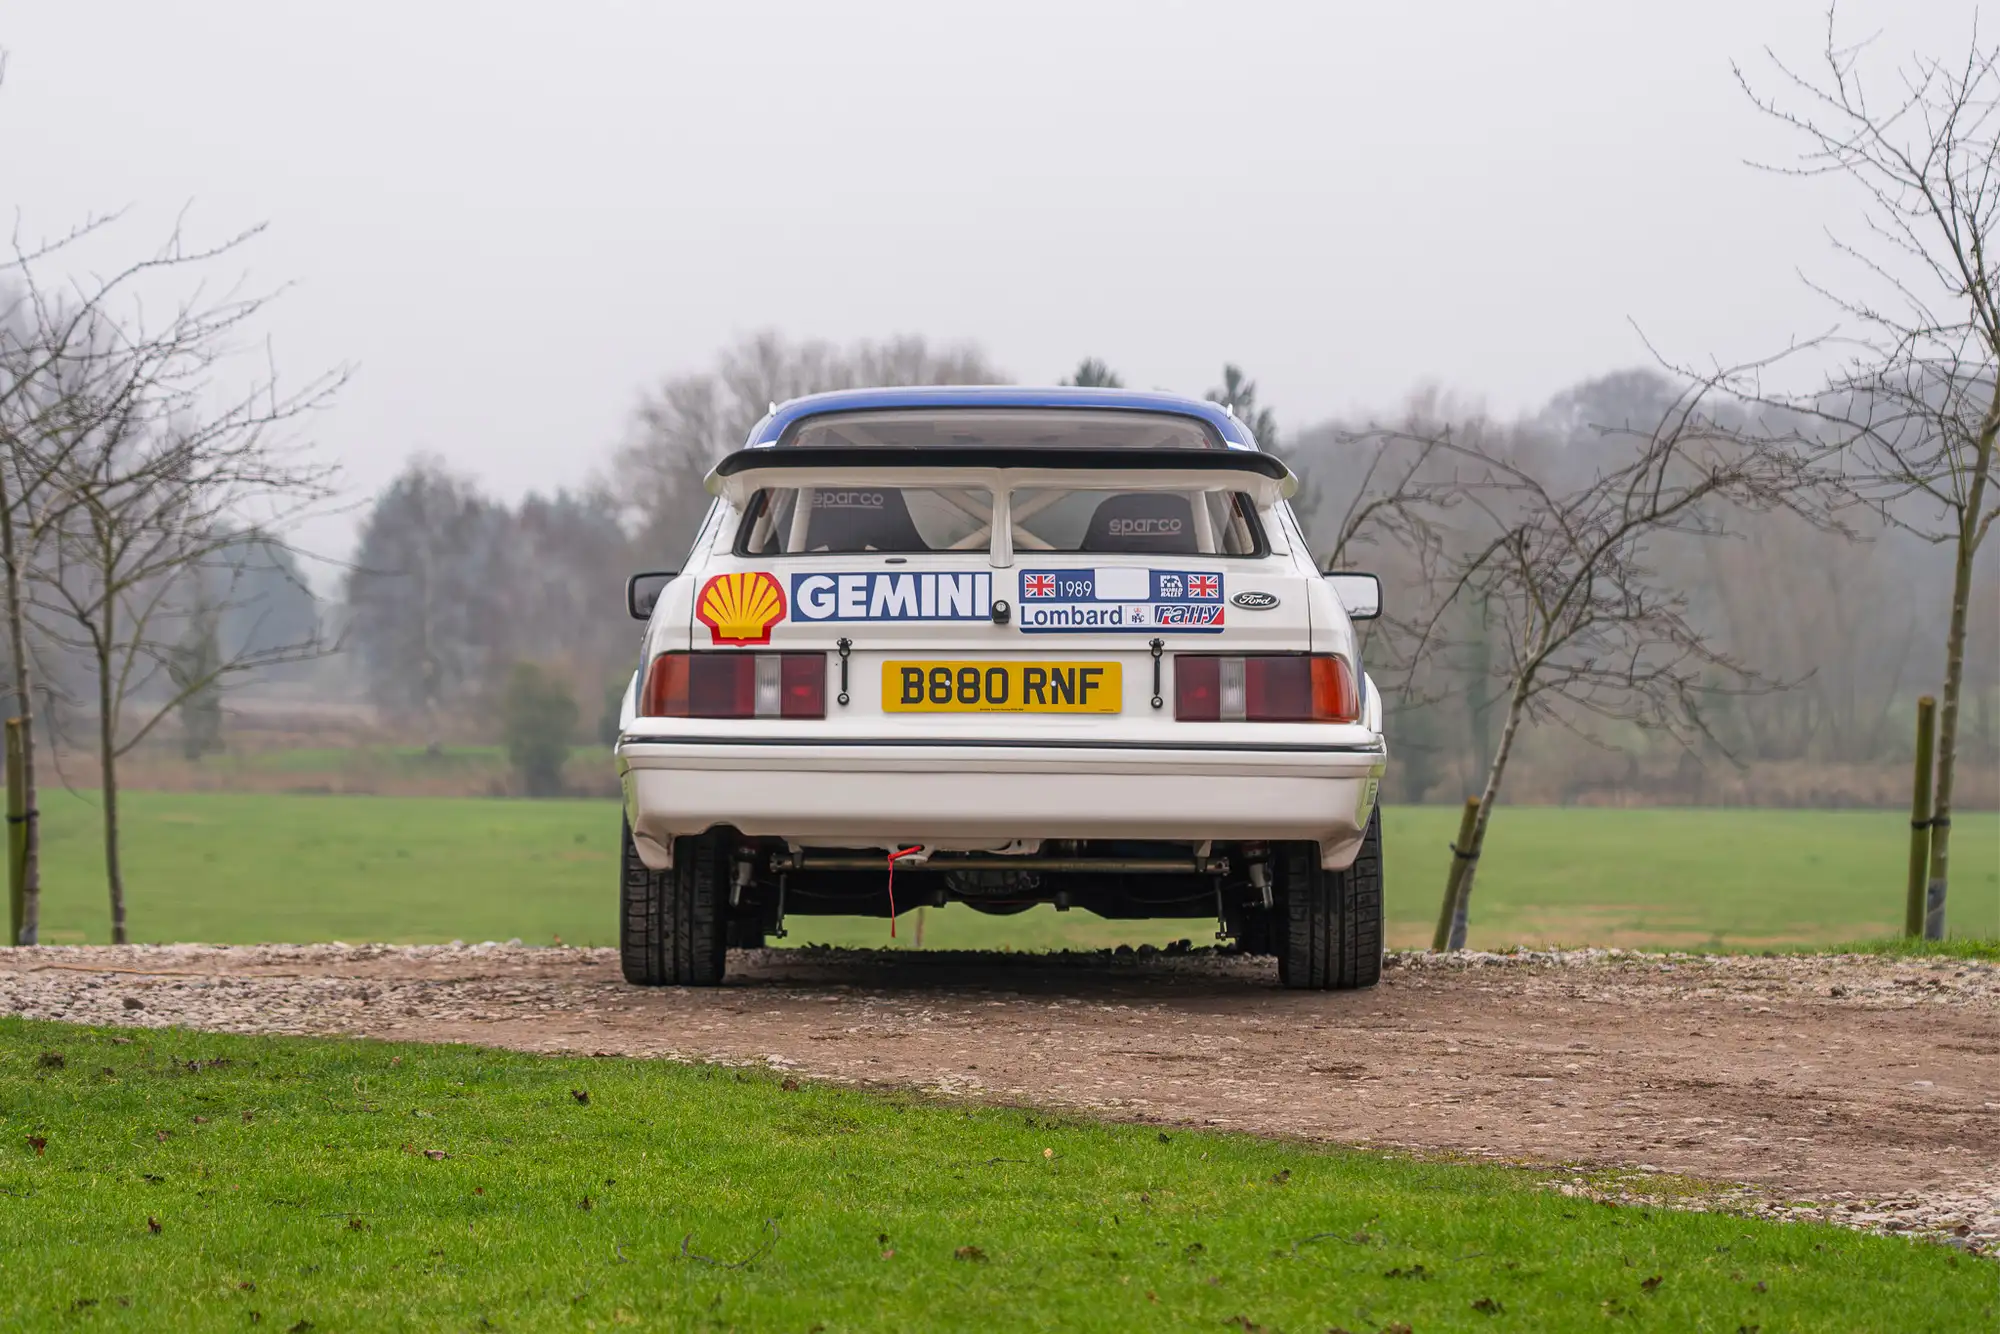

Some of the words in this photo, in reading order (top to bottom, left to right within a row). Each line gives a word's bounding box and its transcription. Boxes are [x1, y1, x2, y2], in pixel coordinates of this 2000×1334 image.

[1109, 518, 1182, 536] sparco
[796, 574, 990, 619] GEMINI
[1058, 581, 1092, 598] 1989
[1239, 594, 1272, 605] Ford
[1020, 605, 1123, 626] Lombard
[1156, 605, 1222, 625] rally
[900, 667, 1009, 704] B880
[1023, 668, 1103, 705] RNF
